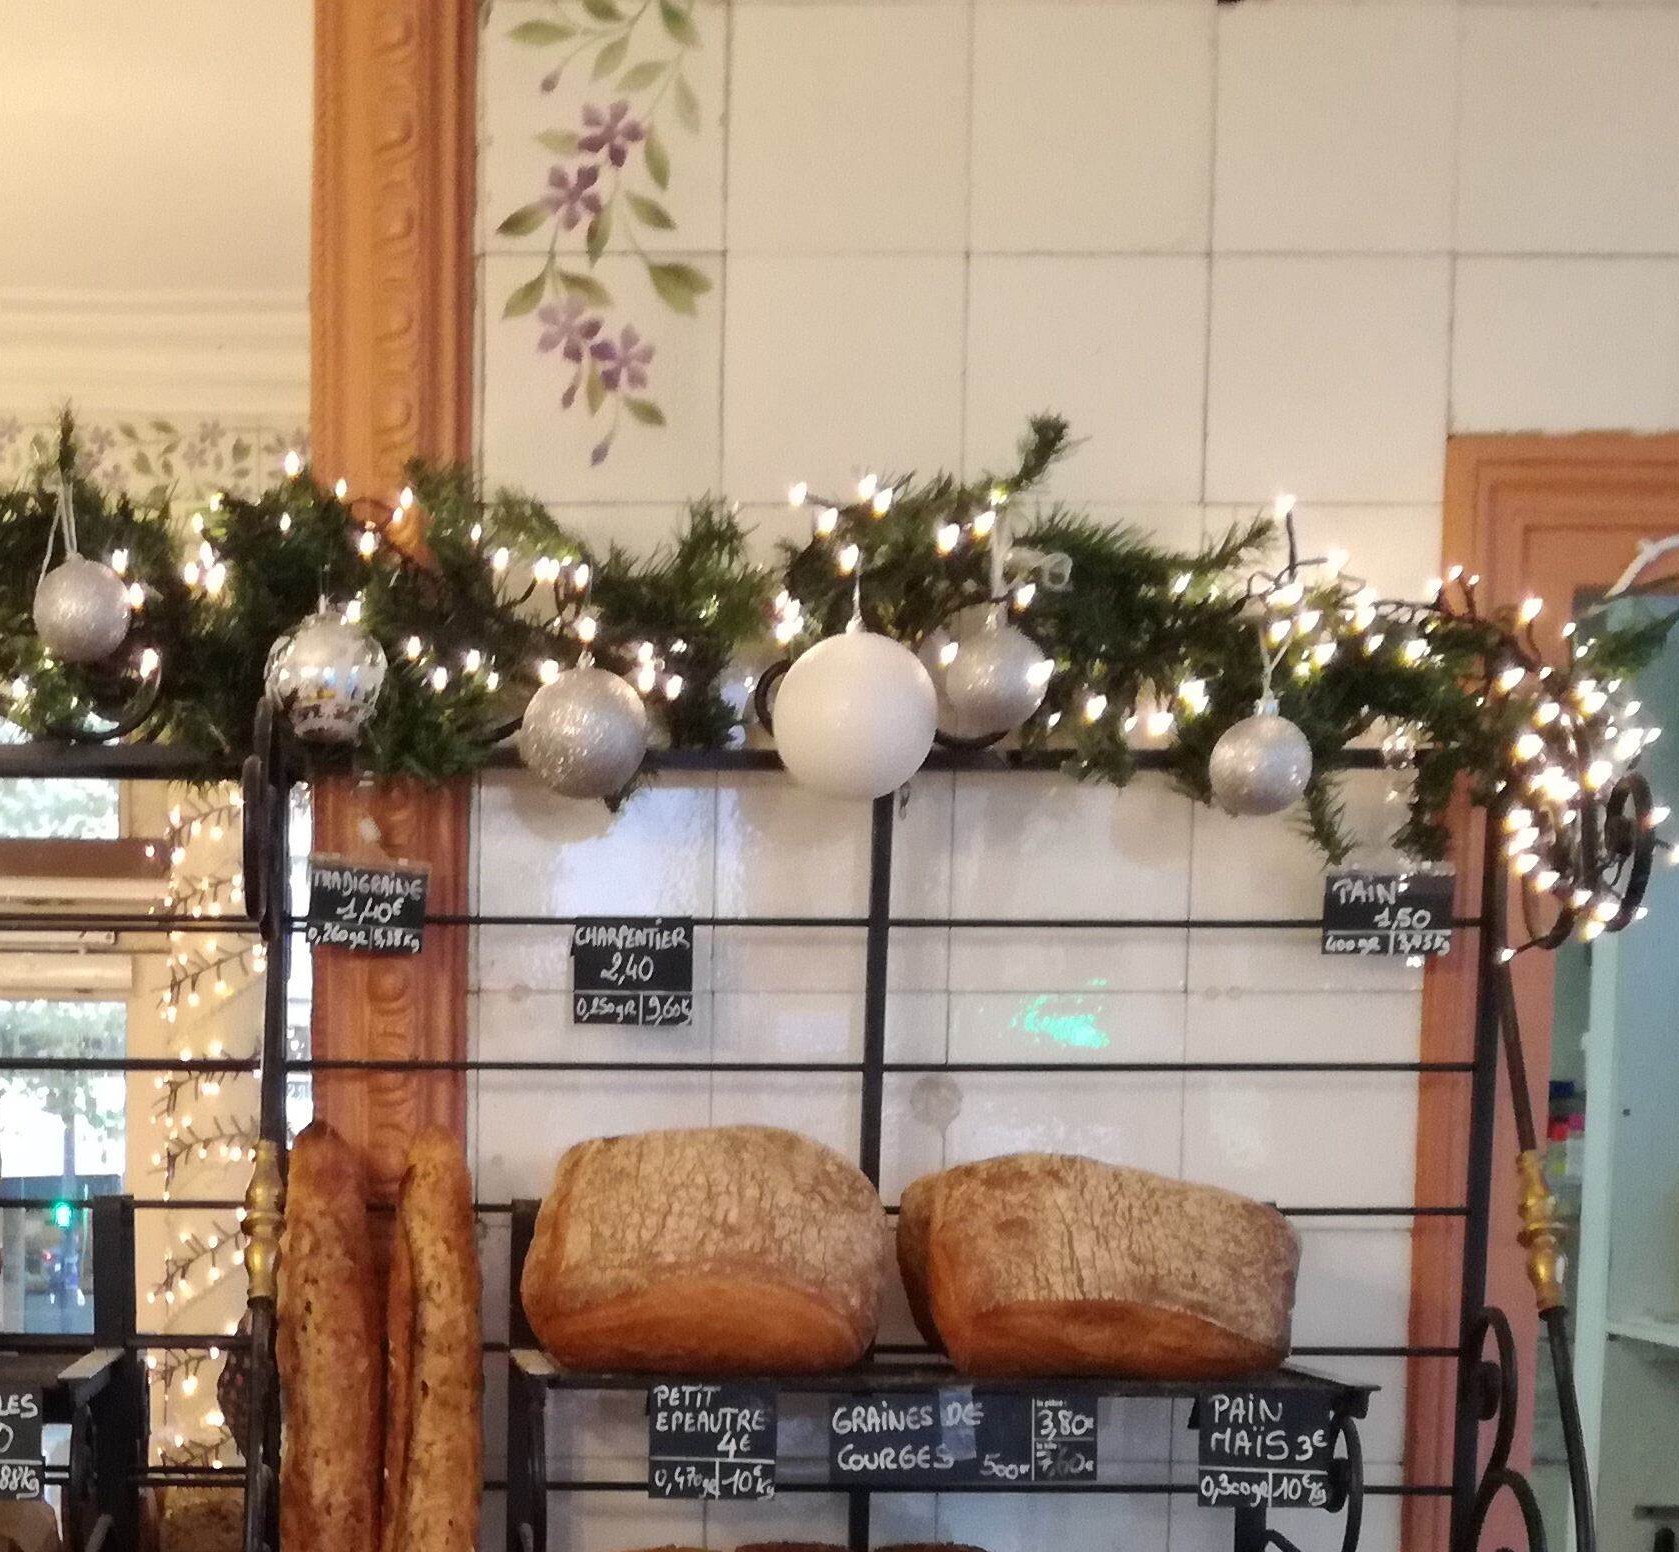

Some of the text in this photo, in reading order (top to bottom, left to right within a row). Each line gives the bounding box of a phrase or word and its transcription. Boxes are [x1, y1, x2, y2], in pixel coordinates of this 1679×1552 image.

[1331, 877, 1397, 905] PAIN
[575, 920, 691, 950] CHARPENTIER
[600, 952, 655, 985] 2,40
[653, 1384, 722, 1408] PETIT
[1208, 1393, 1283, 1424] PAIN
[655, 1407, 766, 1434] EPEAUTRE
[832, 1400, 985, 1434] GRAINES DE
[837, 1443, 955, 1472] COURGES
